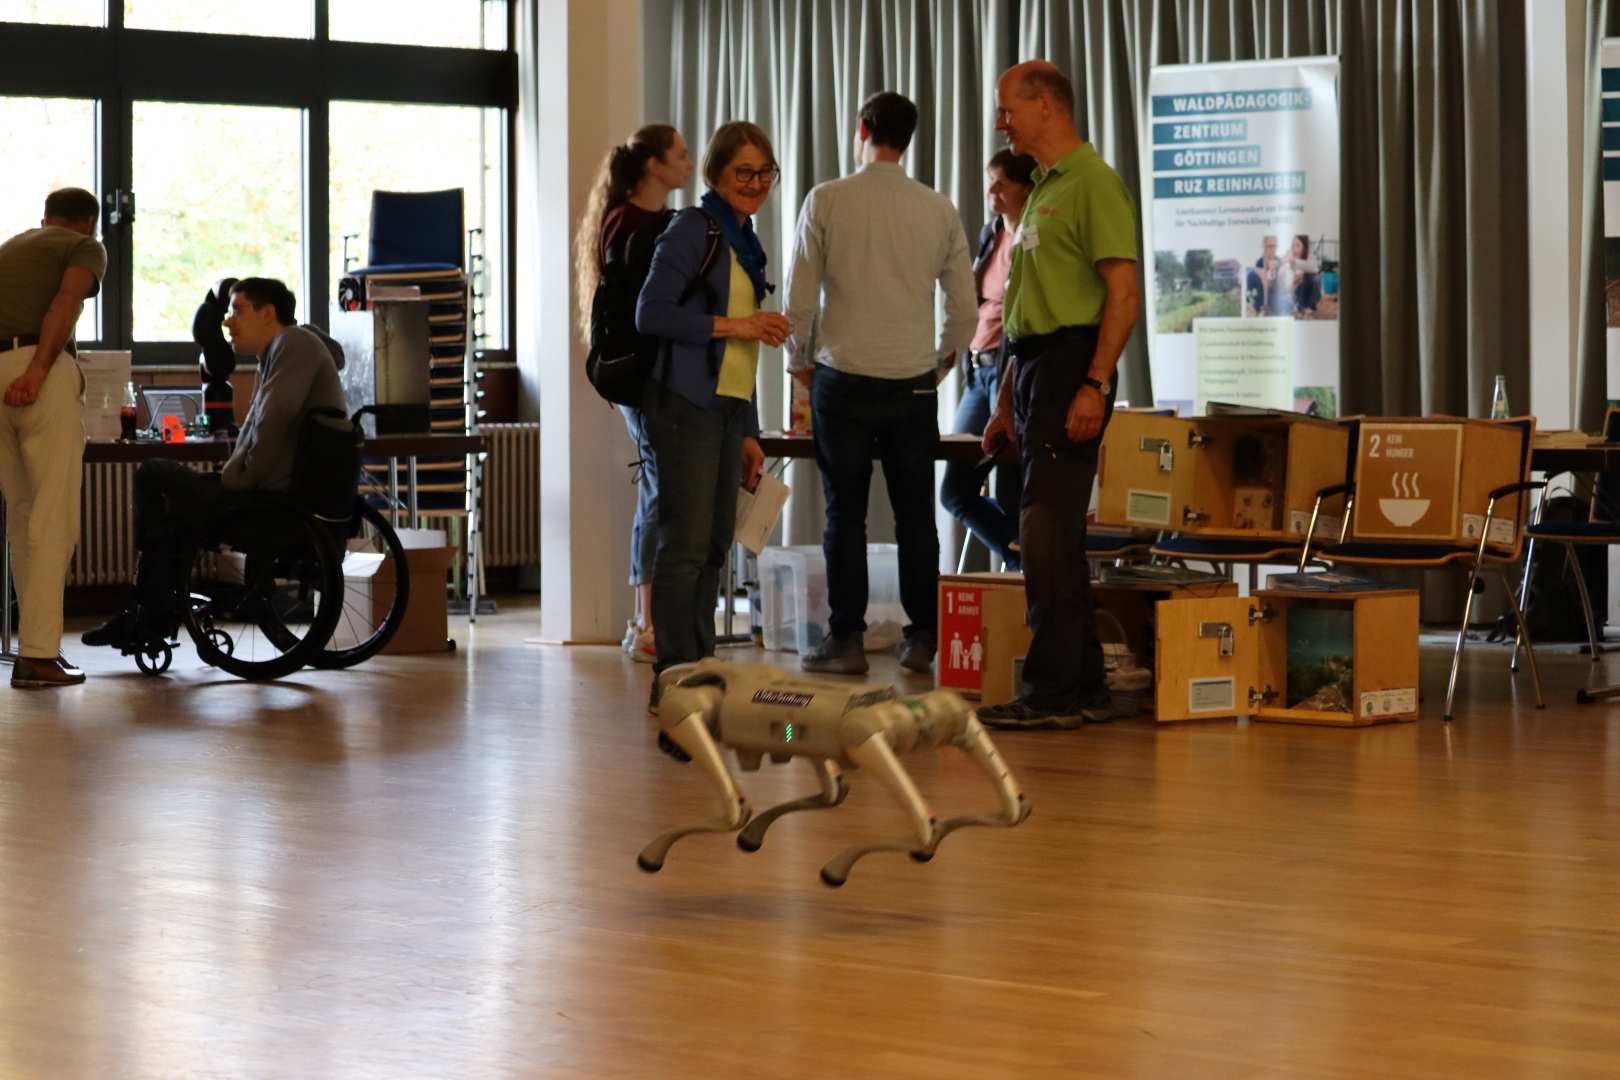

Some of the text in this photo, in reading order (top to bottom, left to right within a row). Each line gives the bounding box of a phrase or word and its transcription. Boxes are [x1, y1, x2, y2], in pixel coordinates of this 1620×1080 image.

[1174, 124, 1244, 139] ZENTRUM
[1174, 150, 1257, 166] GÖTTINGEN
[1174, 176, 1302, 193] RUZ REINHAUSEN
[1369, 434, 1380, 457] 2
[946, 591, 953, 614] 1
